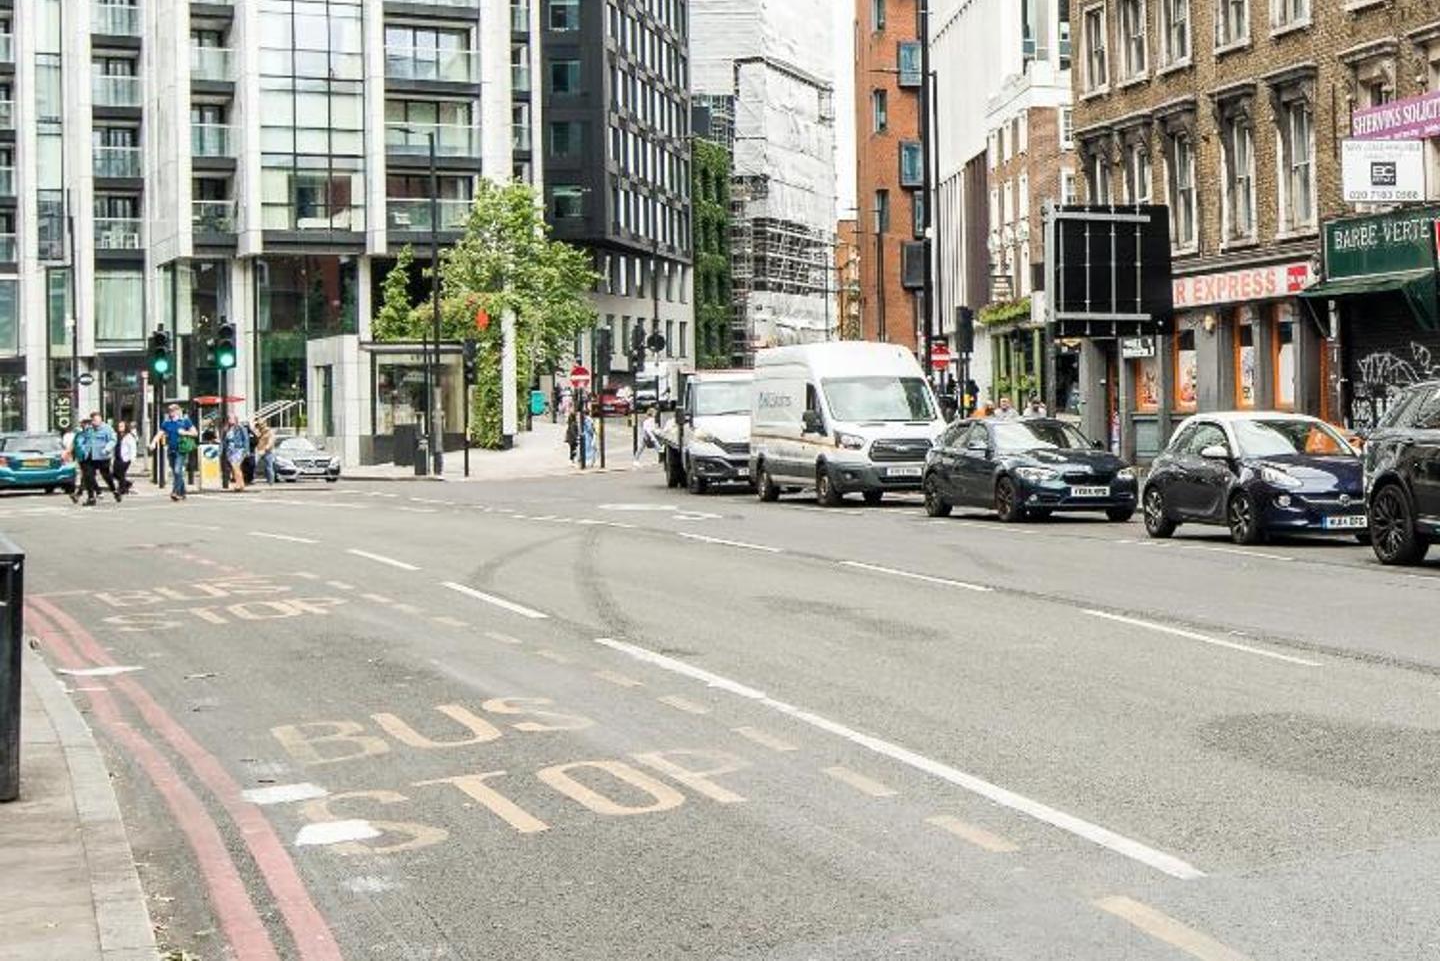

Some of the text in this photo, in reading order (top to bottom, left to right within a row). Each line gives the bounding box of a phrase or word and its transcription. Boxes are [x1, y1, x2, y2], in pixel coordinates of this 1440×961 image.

[1193, 269, 1276, 303] EXPRESS
[94, 575, 292, 607] BUS
[101, 597, 349, 632] STOP
[269, 696, 596, 768] BUS
[296, 748, 757, 856] STOP
